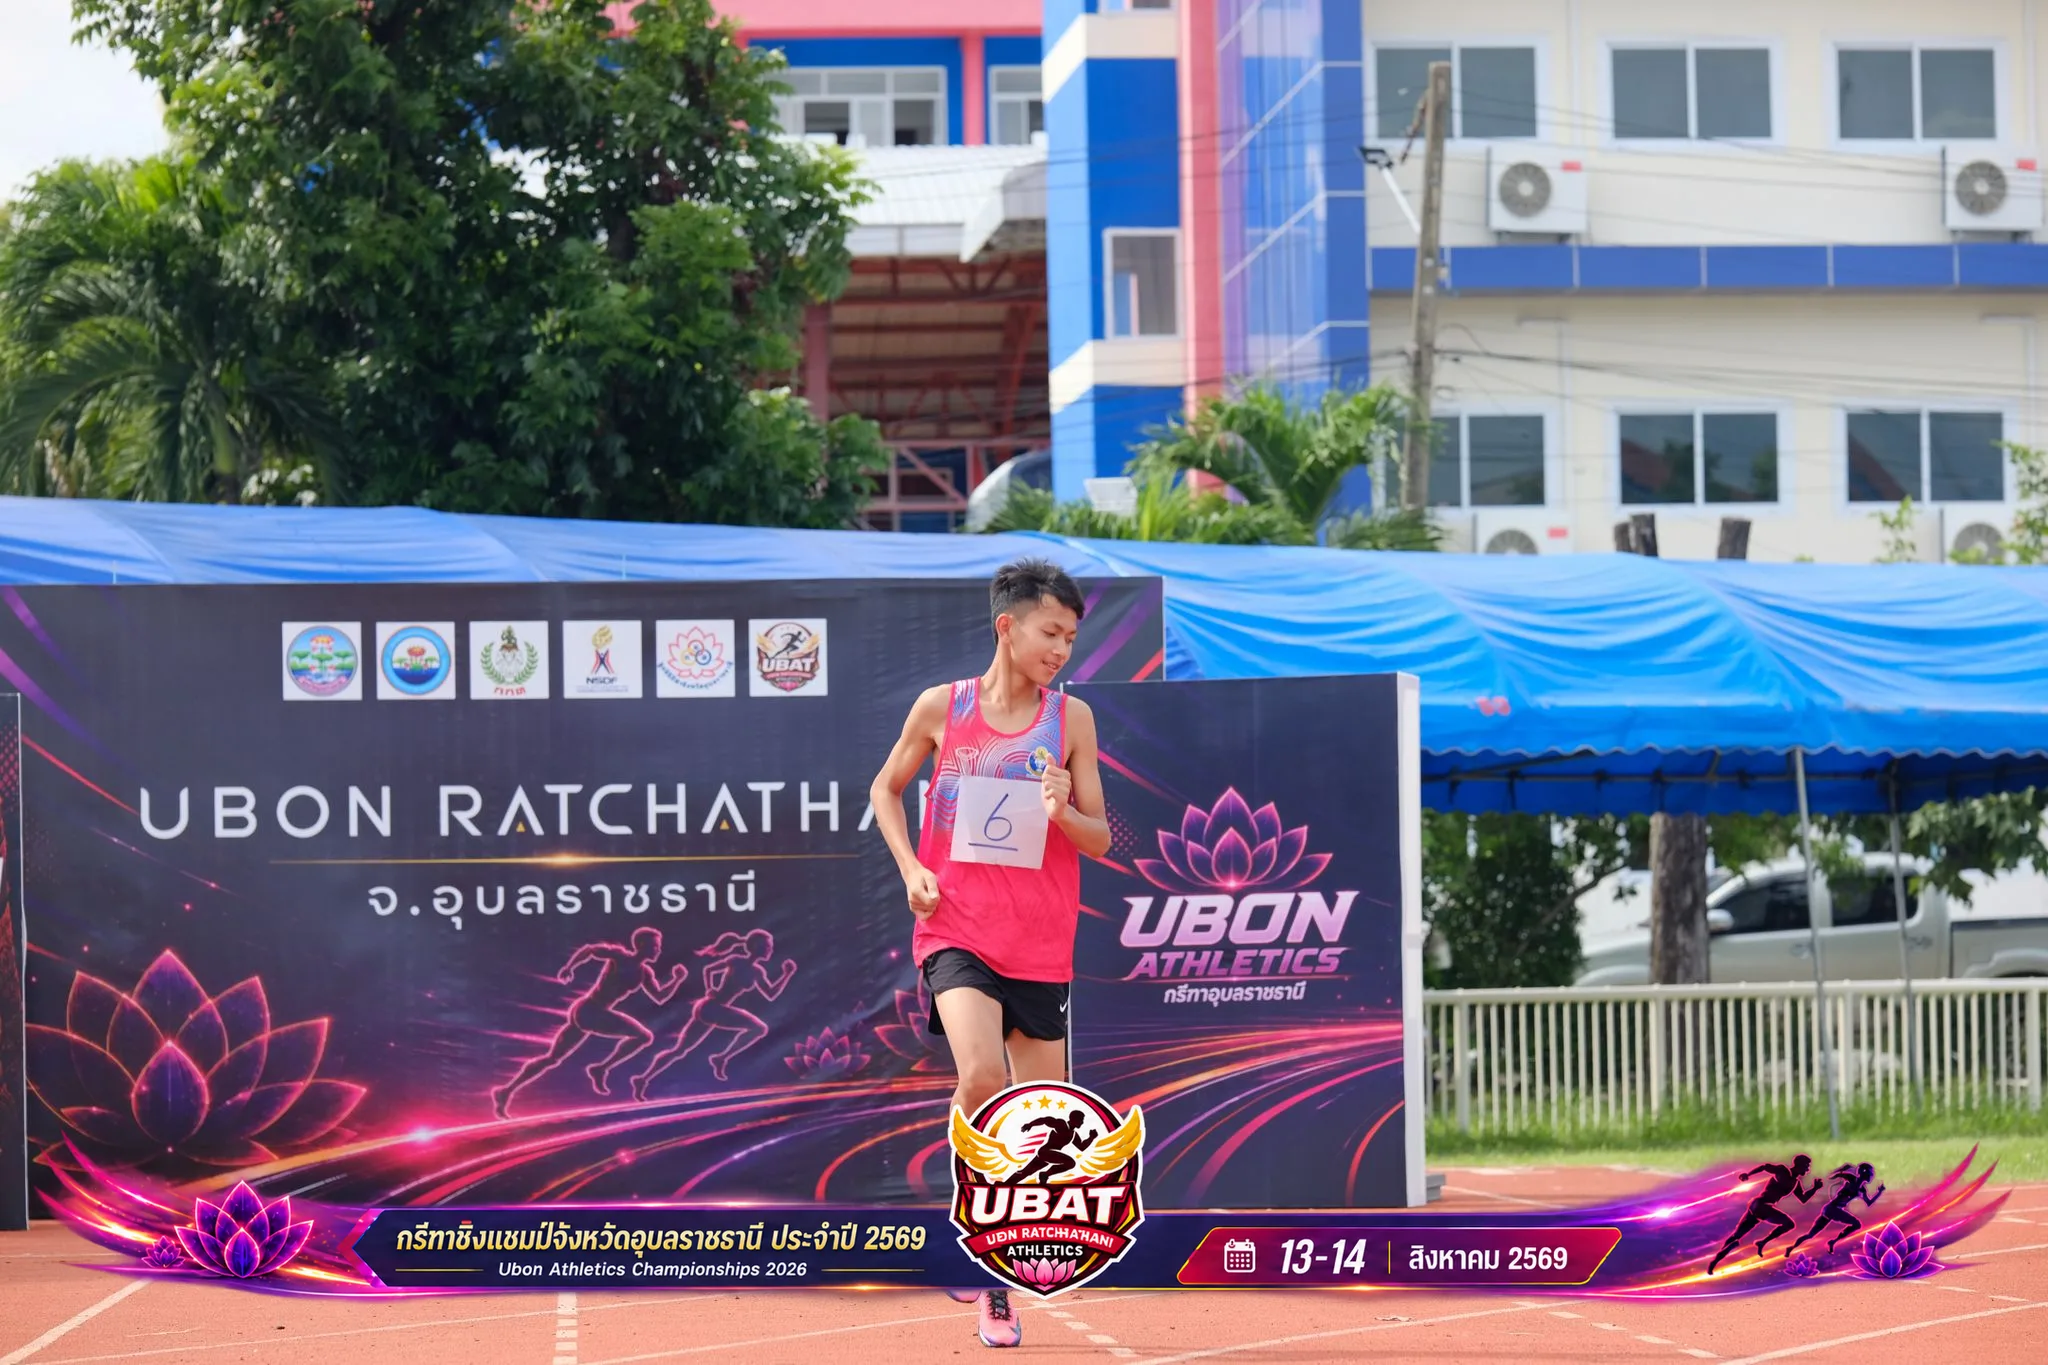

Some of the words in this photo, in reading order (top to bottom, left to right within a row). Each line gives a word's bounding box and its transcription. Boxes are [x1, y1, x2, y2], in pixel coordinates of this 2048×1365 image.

[762, 657, 815, 674] UBAT
[140, 785, 392, 840] UBON
[439, 779, 930, 837] RATCHATH
[983, 793, 1012, 842] 6
[368, 869, 756, 930] จ.อุบลราชธานี
[1119, 890, 1360, 947] UBON
[1125, 945, 1346, 979] ATHLETICS
